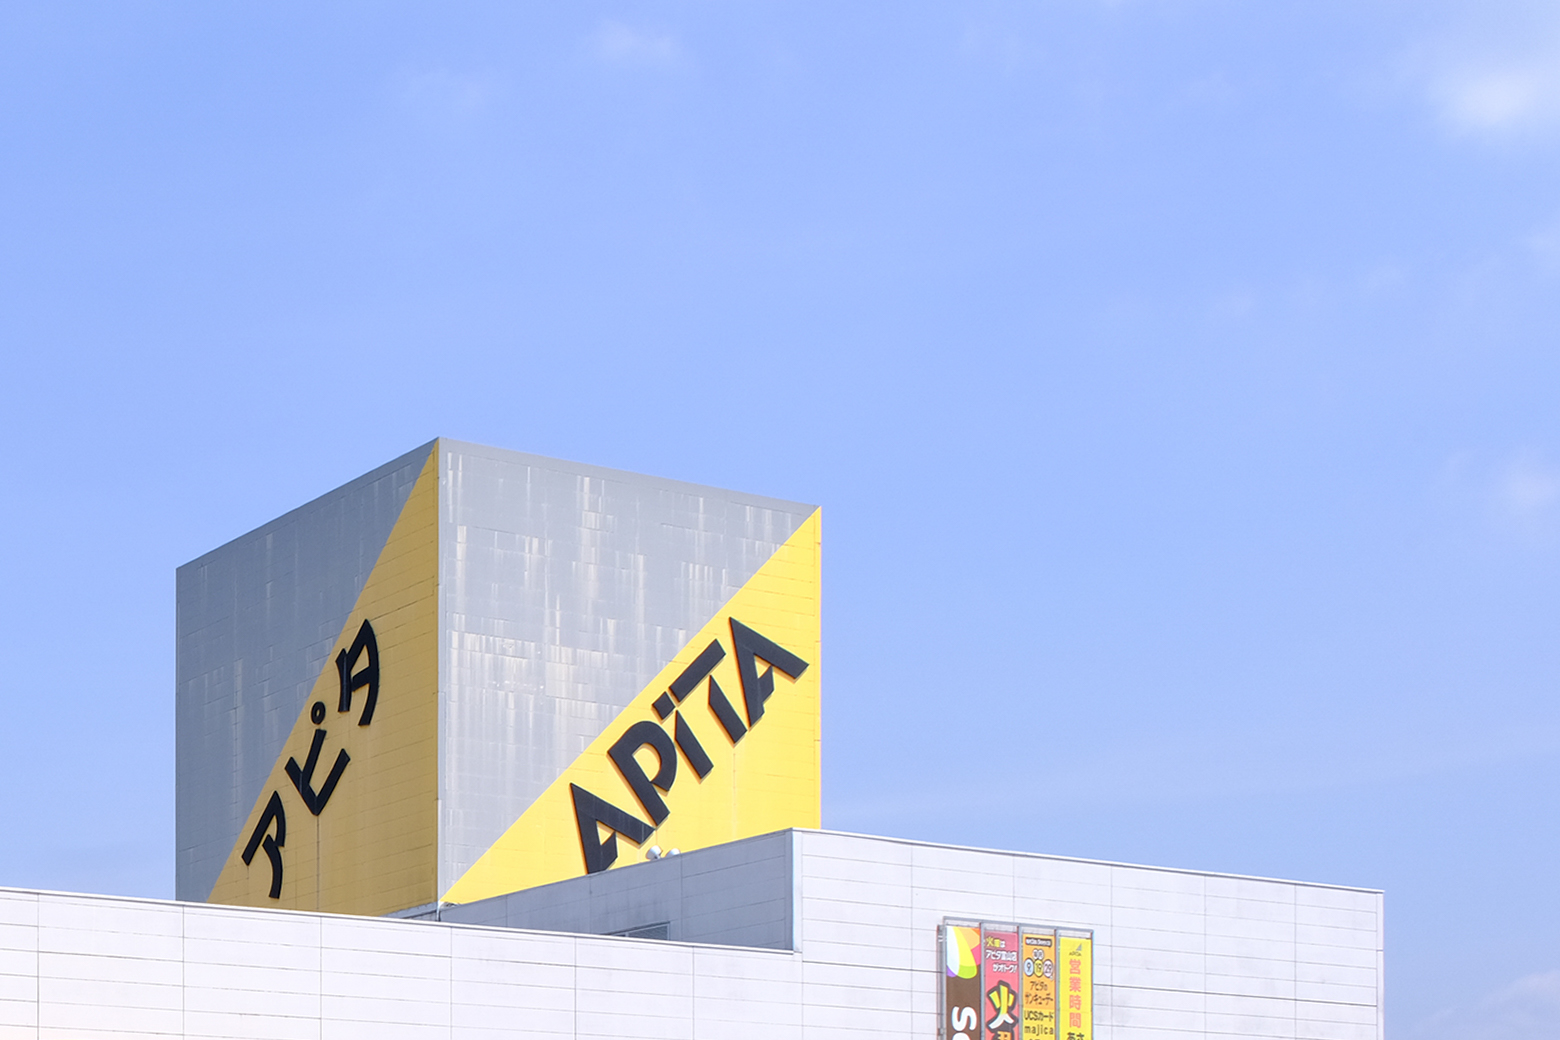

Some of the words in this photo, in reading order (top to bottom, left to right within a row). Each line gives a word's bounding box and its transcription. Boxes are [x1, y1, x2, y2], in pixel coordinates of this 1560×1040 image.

[241, 618, 380, 899] アピタ
[1068, 958, 1082, 1029] 営業時間
[1024, 1010, 1054, 1022] UCSカード
[1024, 1024, 1055, 1036] majica
